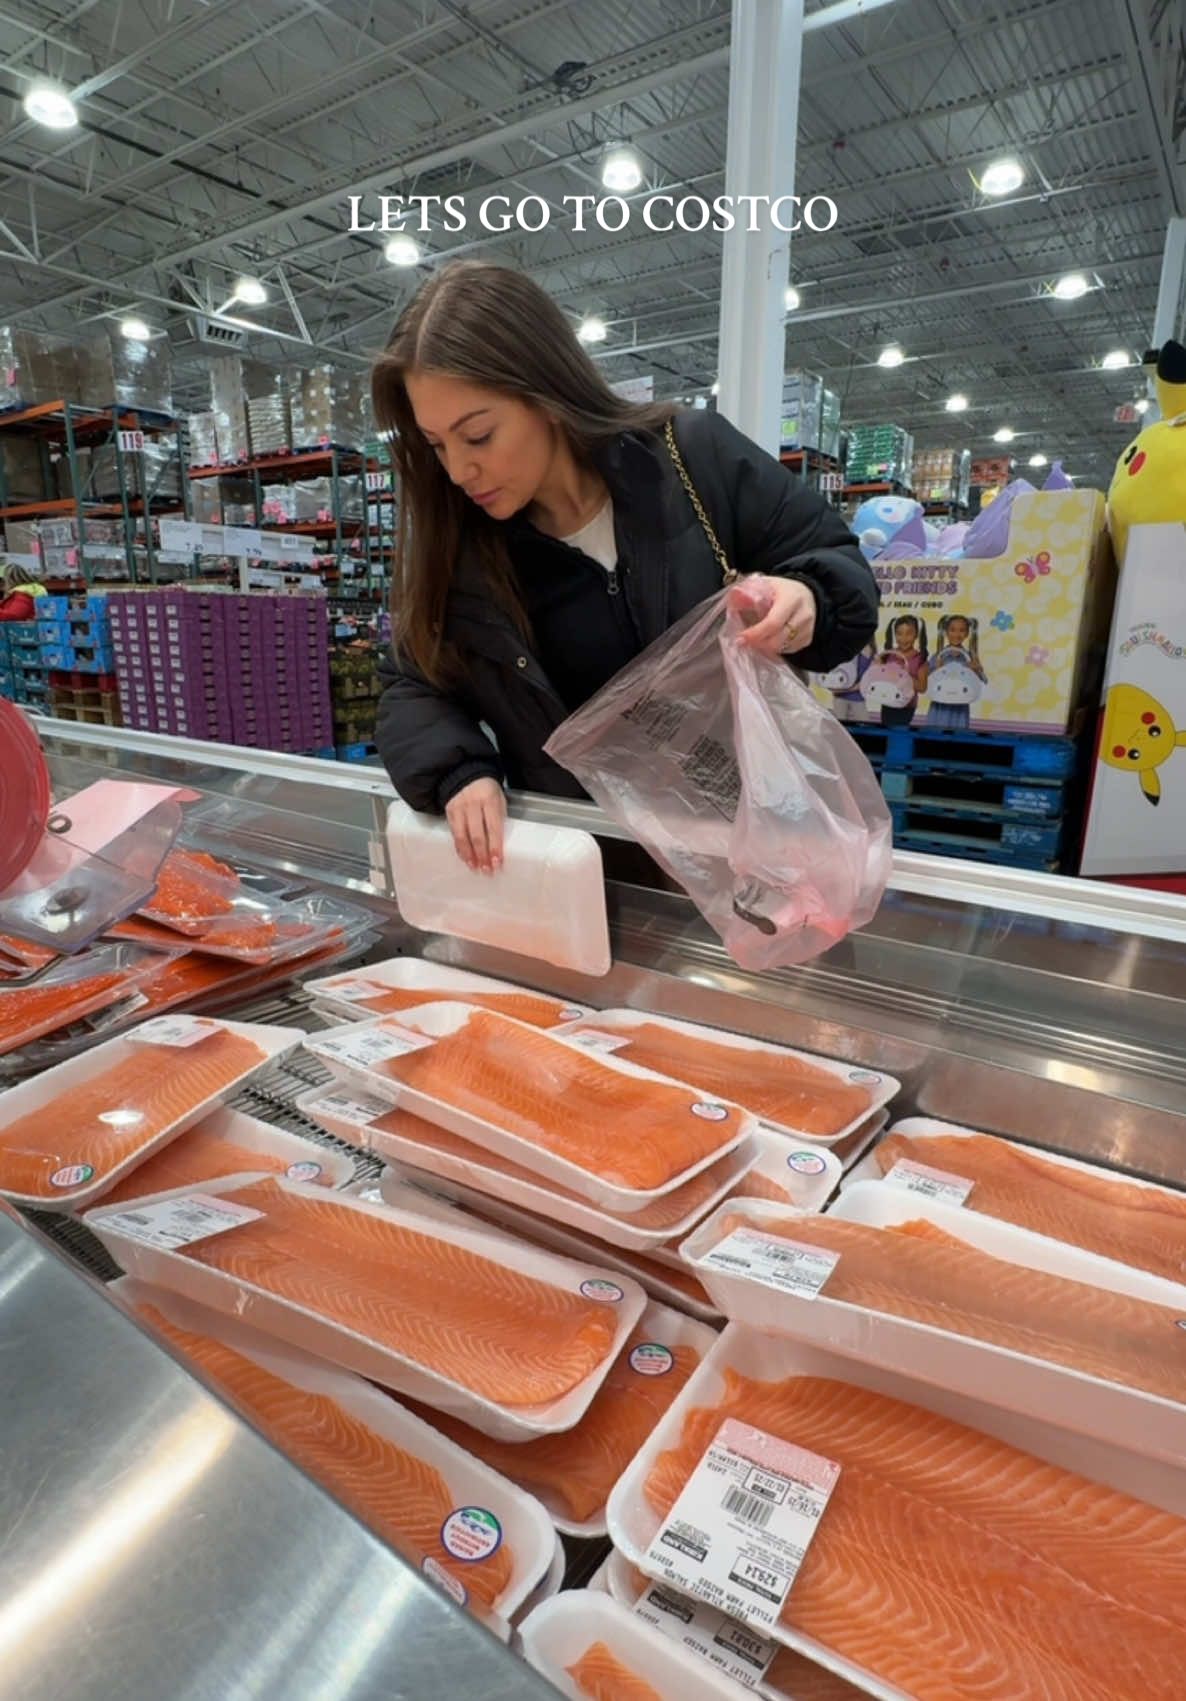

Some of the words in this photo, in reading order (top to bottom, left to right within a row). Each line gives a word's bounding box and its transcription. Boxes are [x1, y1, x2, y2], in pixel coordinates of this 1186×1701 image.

[122, 433, 143, 449] 119
[368, 474, 385, 487] 117
[823, 477, 842, 488] 115
[911, 565, 959, 580] KITTY
[894, 581, 957, 595] FRIENDS
[664, 1568, 688, 1586] SALMON
[690, 1581, 724, 1606] ATLANTIC
[699, 1577, 724, 1596] RAISED
[726, 1593, 744, 1606] FARM
[727, 1603, 748, 1621] FRESH
[747, 1602, 773, 1624] FILLET
[709, 1652, 728, 1667] FARM
[728, 1664, 756, 1686] FILLET
